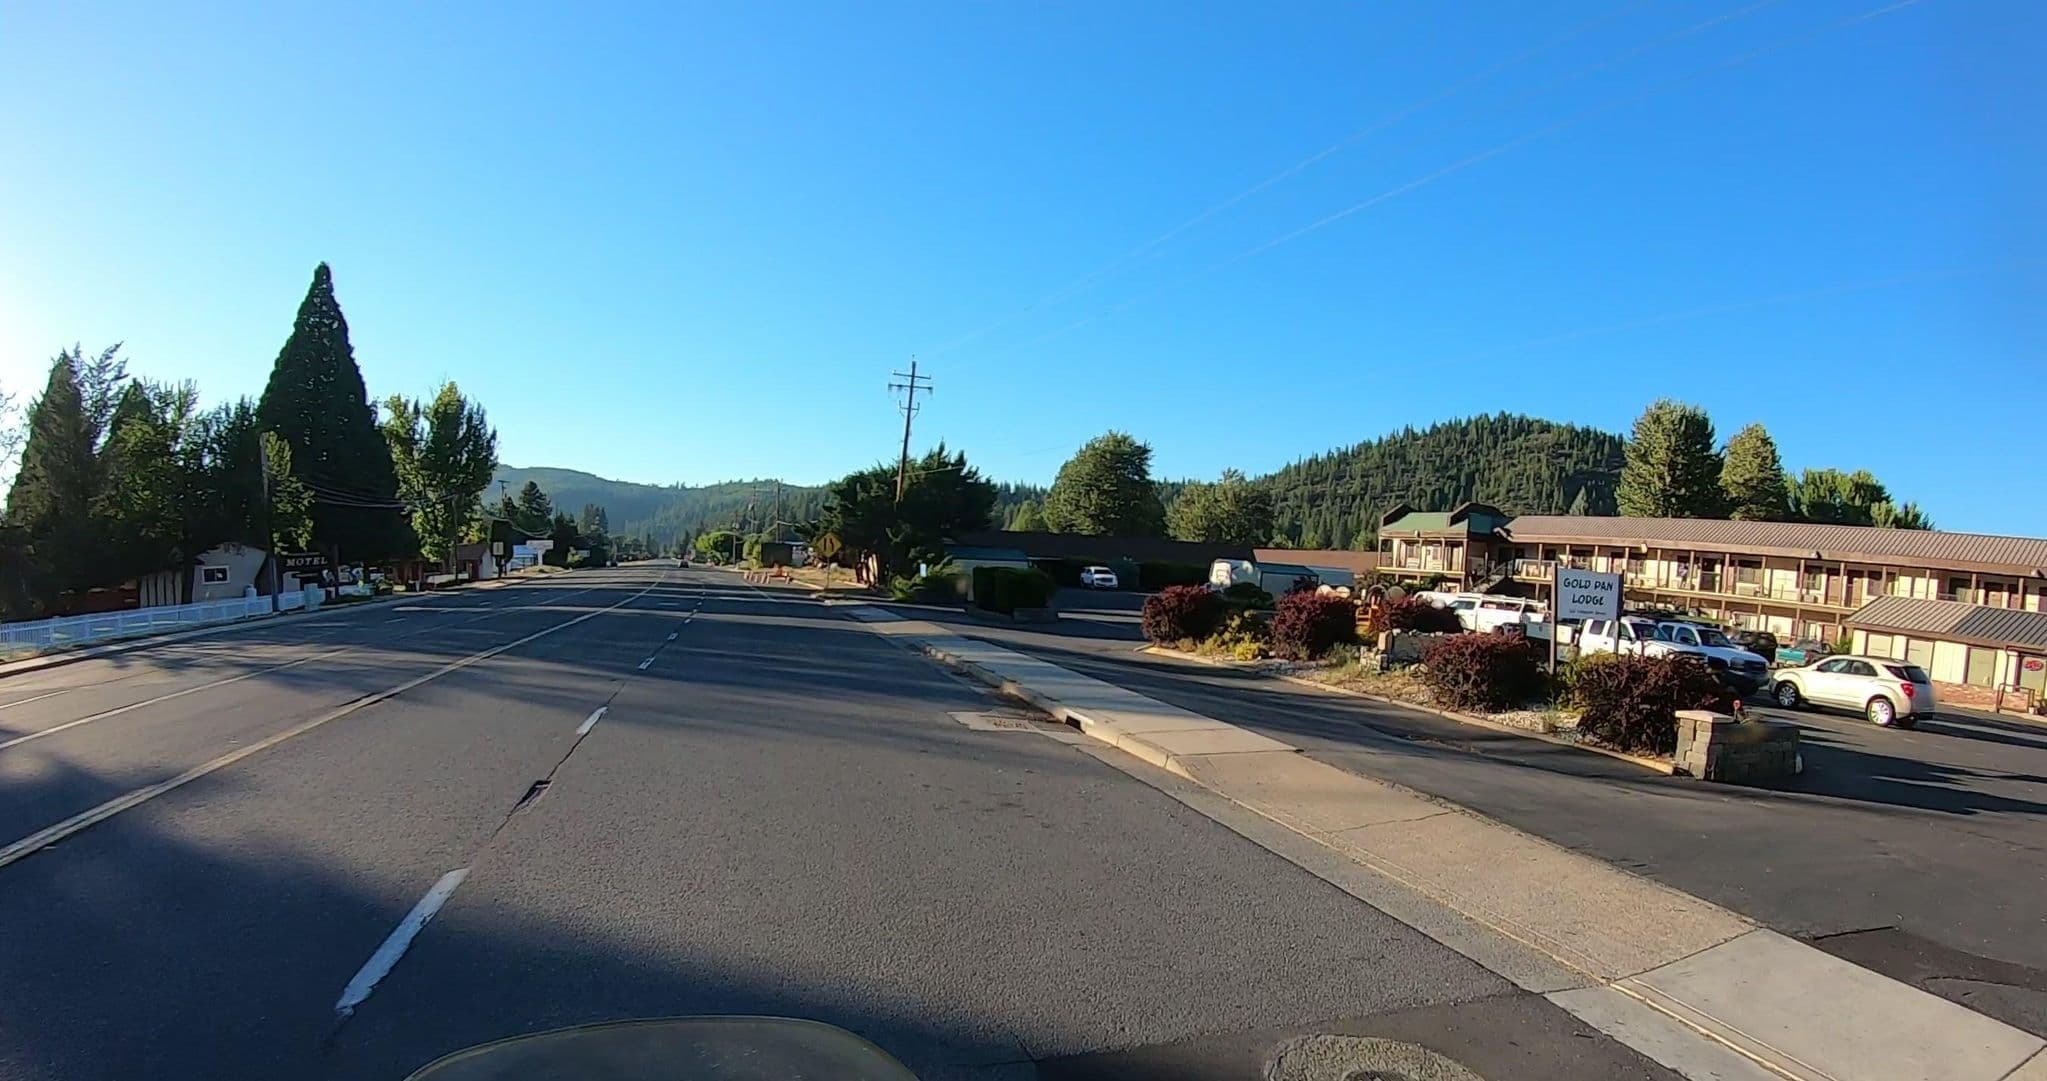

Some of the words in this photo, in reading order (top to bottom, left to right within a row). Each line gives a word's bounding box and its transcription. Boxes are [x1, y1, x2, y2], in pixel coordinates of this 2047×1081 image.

[286, 557, 328, 567] MOTEL
[1563, 577, 1591, 589] GOLD
[1594, 581, 1613, 592] PAN
[1572, 594, 1604, 606] LODGE
